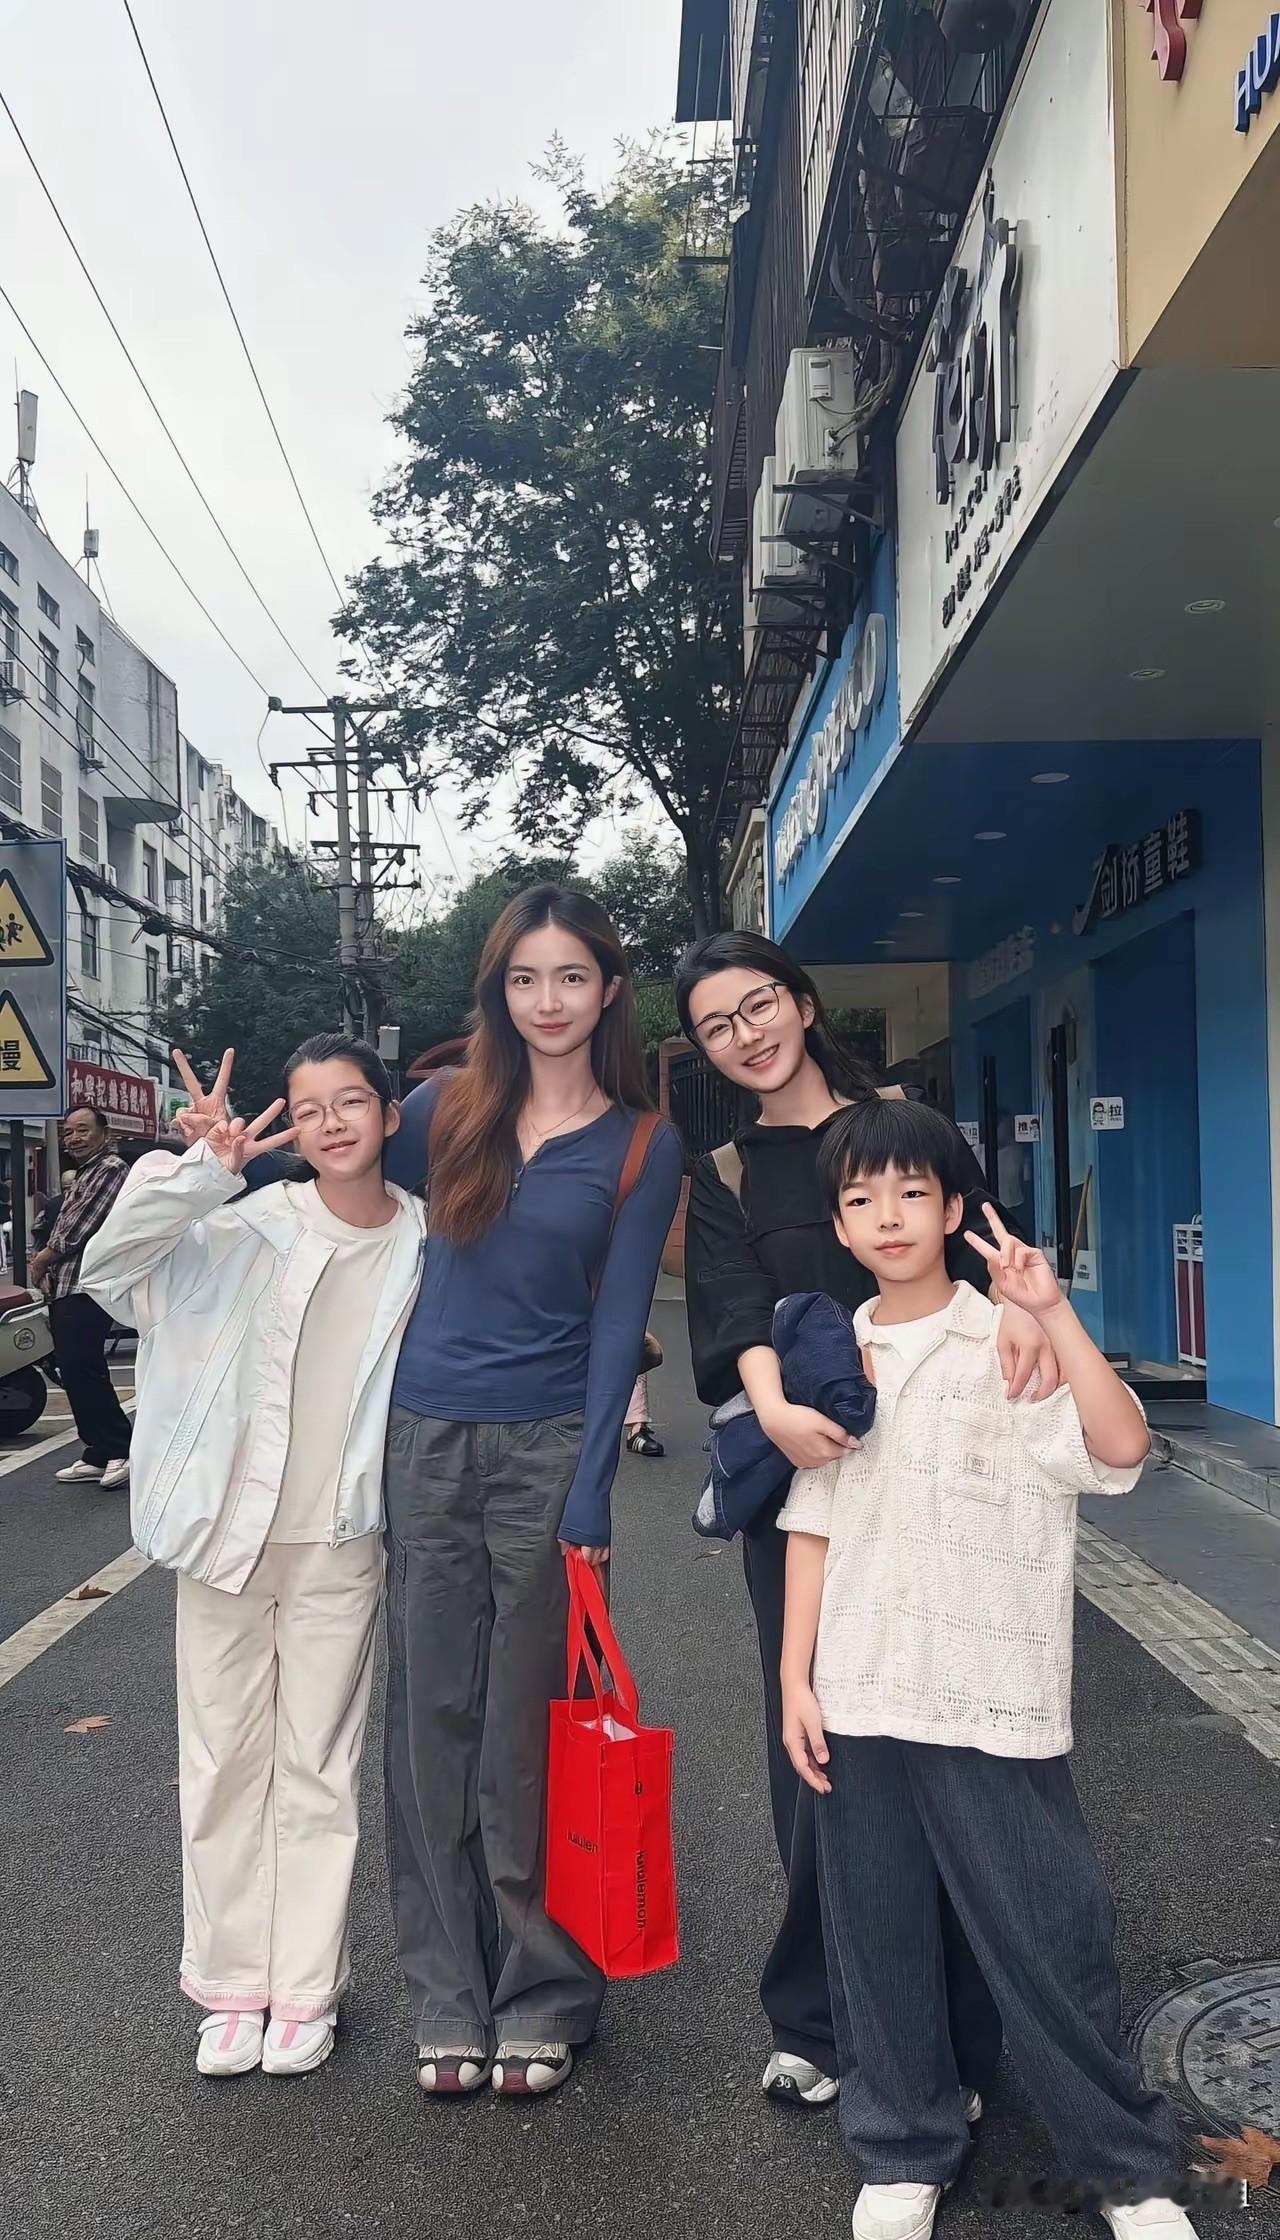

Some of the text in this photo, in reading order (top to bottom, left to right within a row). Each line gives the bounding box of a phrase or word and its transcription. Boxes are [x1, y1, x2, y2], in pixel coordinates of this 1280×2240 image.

[0, 1040, 21, 1071] 慢
[1109, 1104, 1122, 1116] 拉
[776, 2075, 791, 2089] 36
